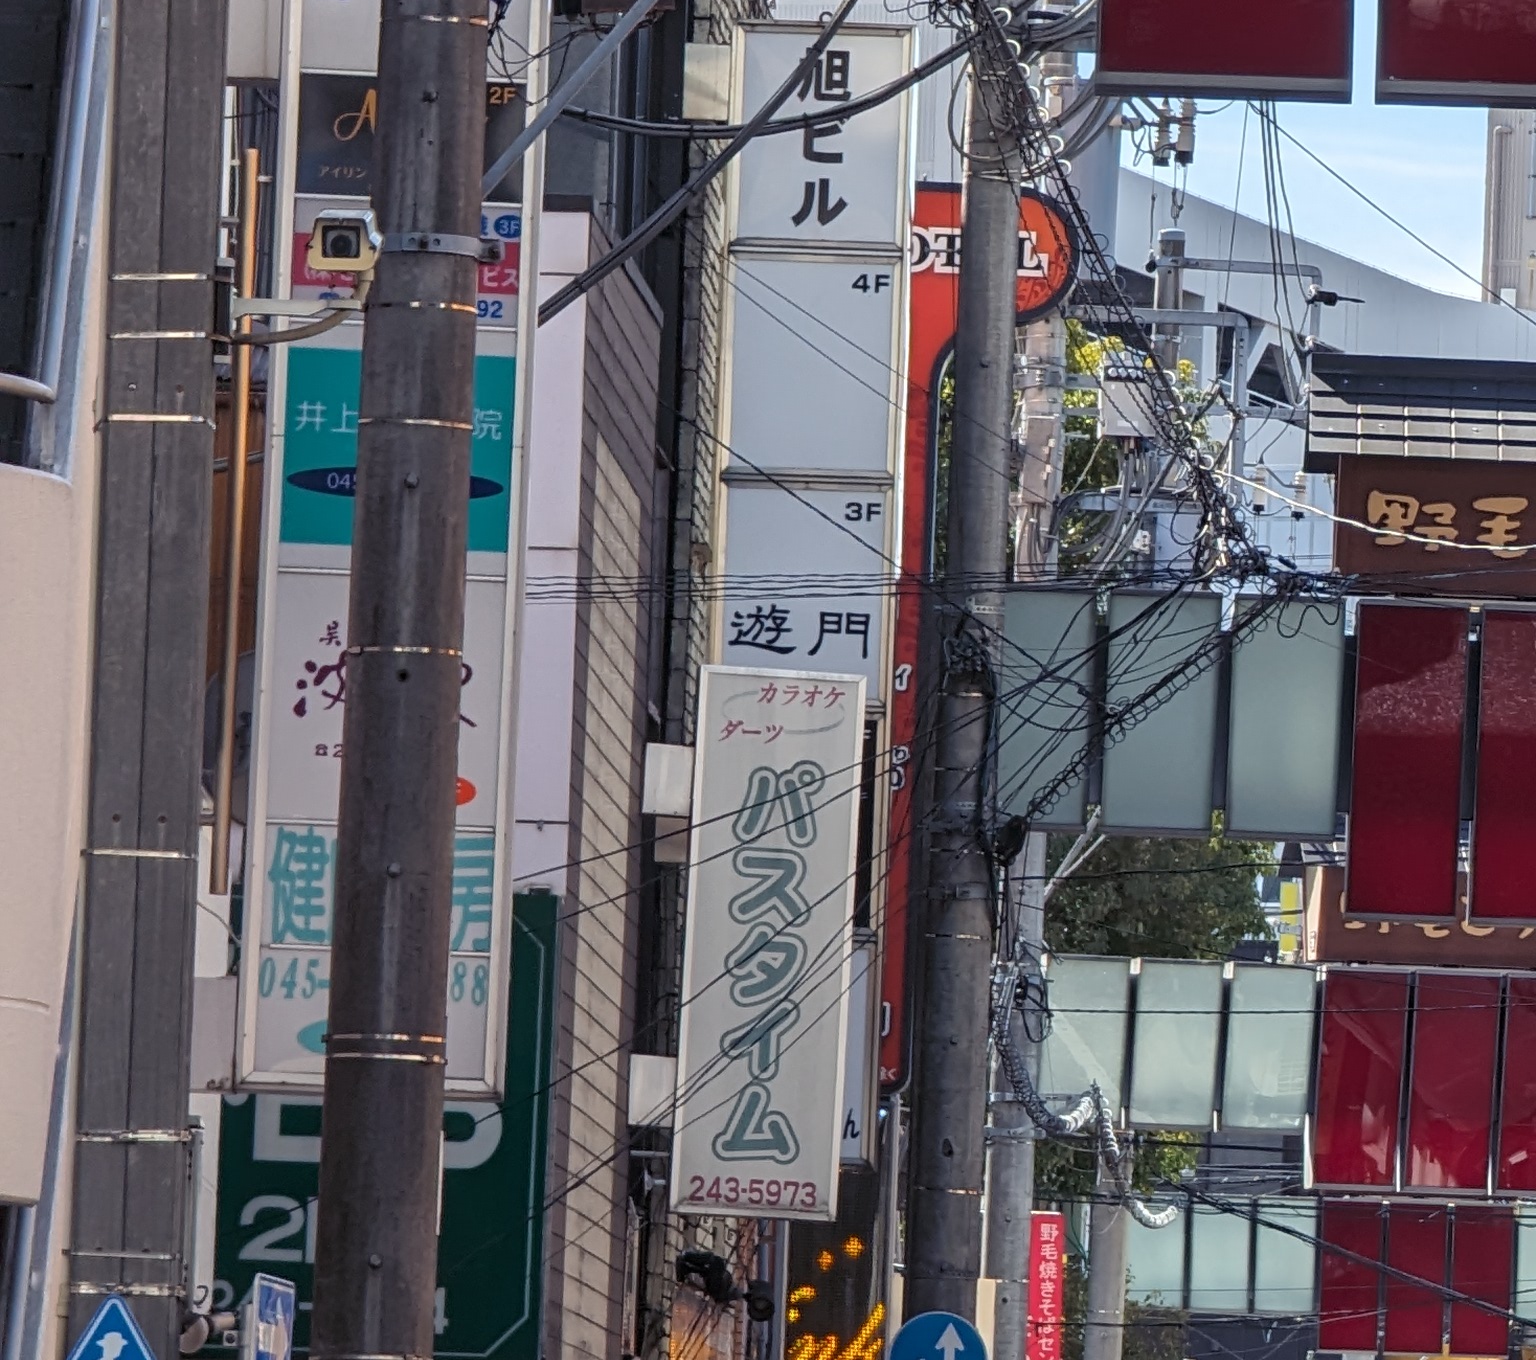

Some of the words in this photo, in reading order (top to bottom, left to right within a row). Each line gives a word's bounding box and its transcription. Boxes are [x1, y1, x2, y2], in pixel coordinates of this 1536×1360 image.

[489, 87, 516, 104] 2F
[791, 49, 851, 228] 旭ビル
[852, 274, 889, 293] 4F
[844, 503, 881, 522] 3F
[729, 604, 872, 660] 遊門
[758, 683, 846, 709] カラオケ
[720, 718, 784, 742] ダーツ
[712, 760, 825, 1165] パスタイム
[688, 1176, 817, 1208] 243-5973
